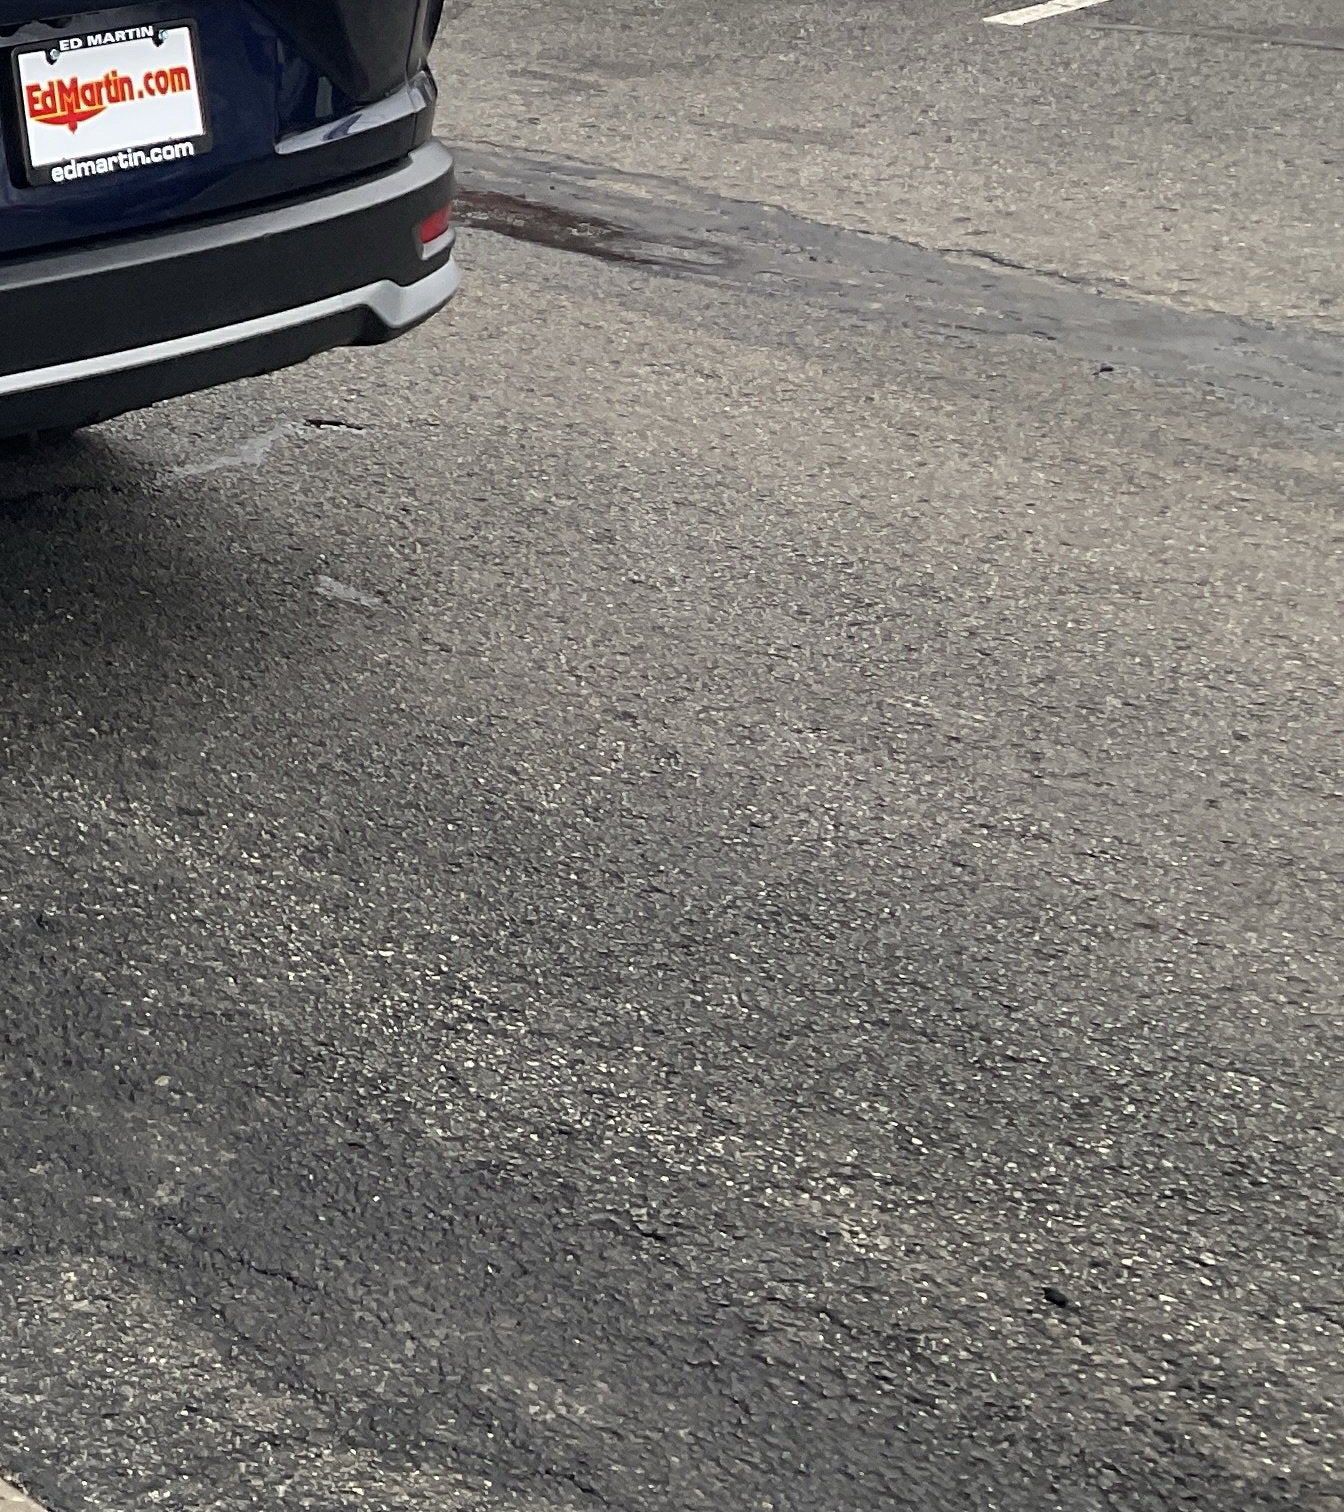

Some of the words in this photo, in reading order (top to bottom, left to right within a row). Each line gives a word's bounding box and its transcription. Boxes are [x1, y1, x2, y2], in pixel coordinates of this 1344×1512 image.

[59, 37, 83, 52] ED
[87, 25, 154, 47] MARTIN
[51, 140, 195, 183] edmartin.com
